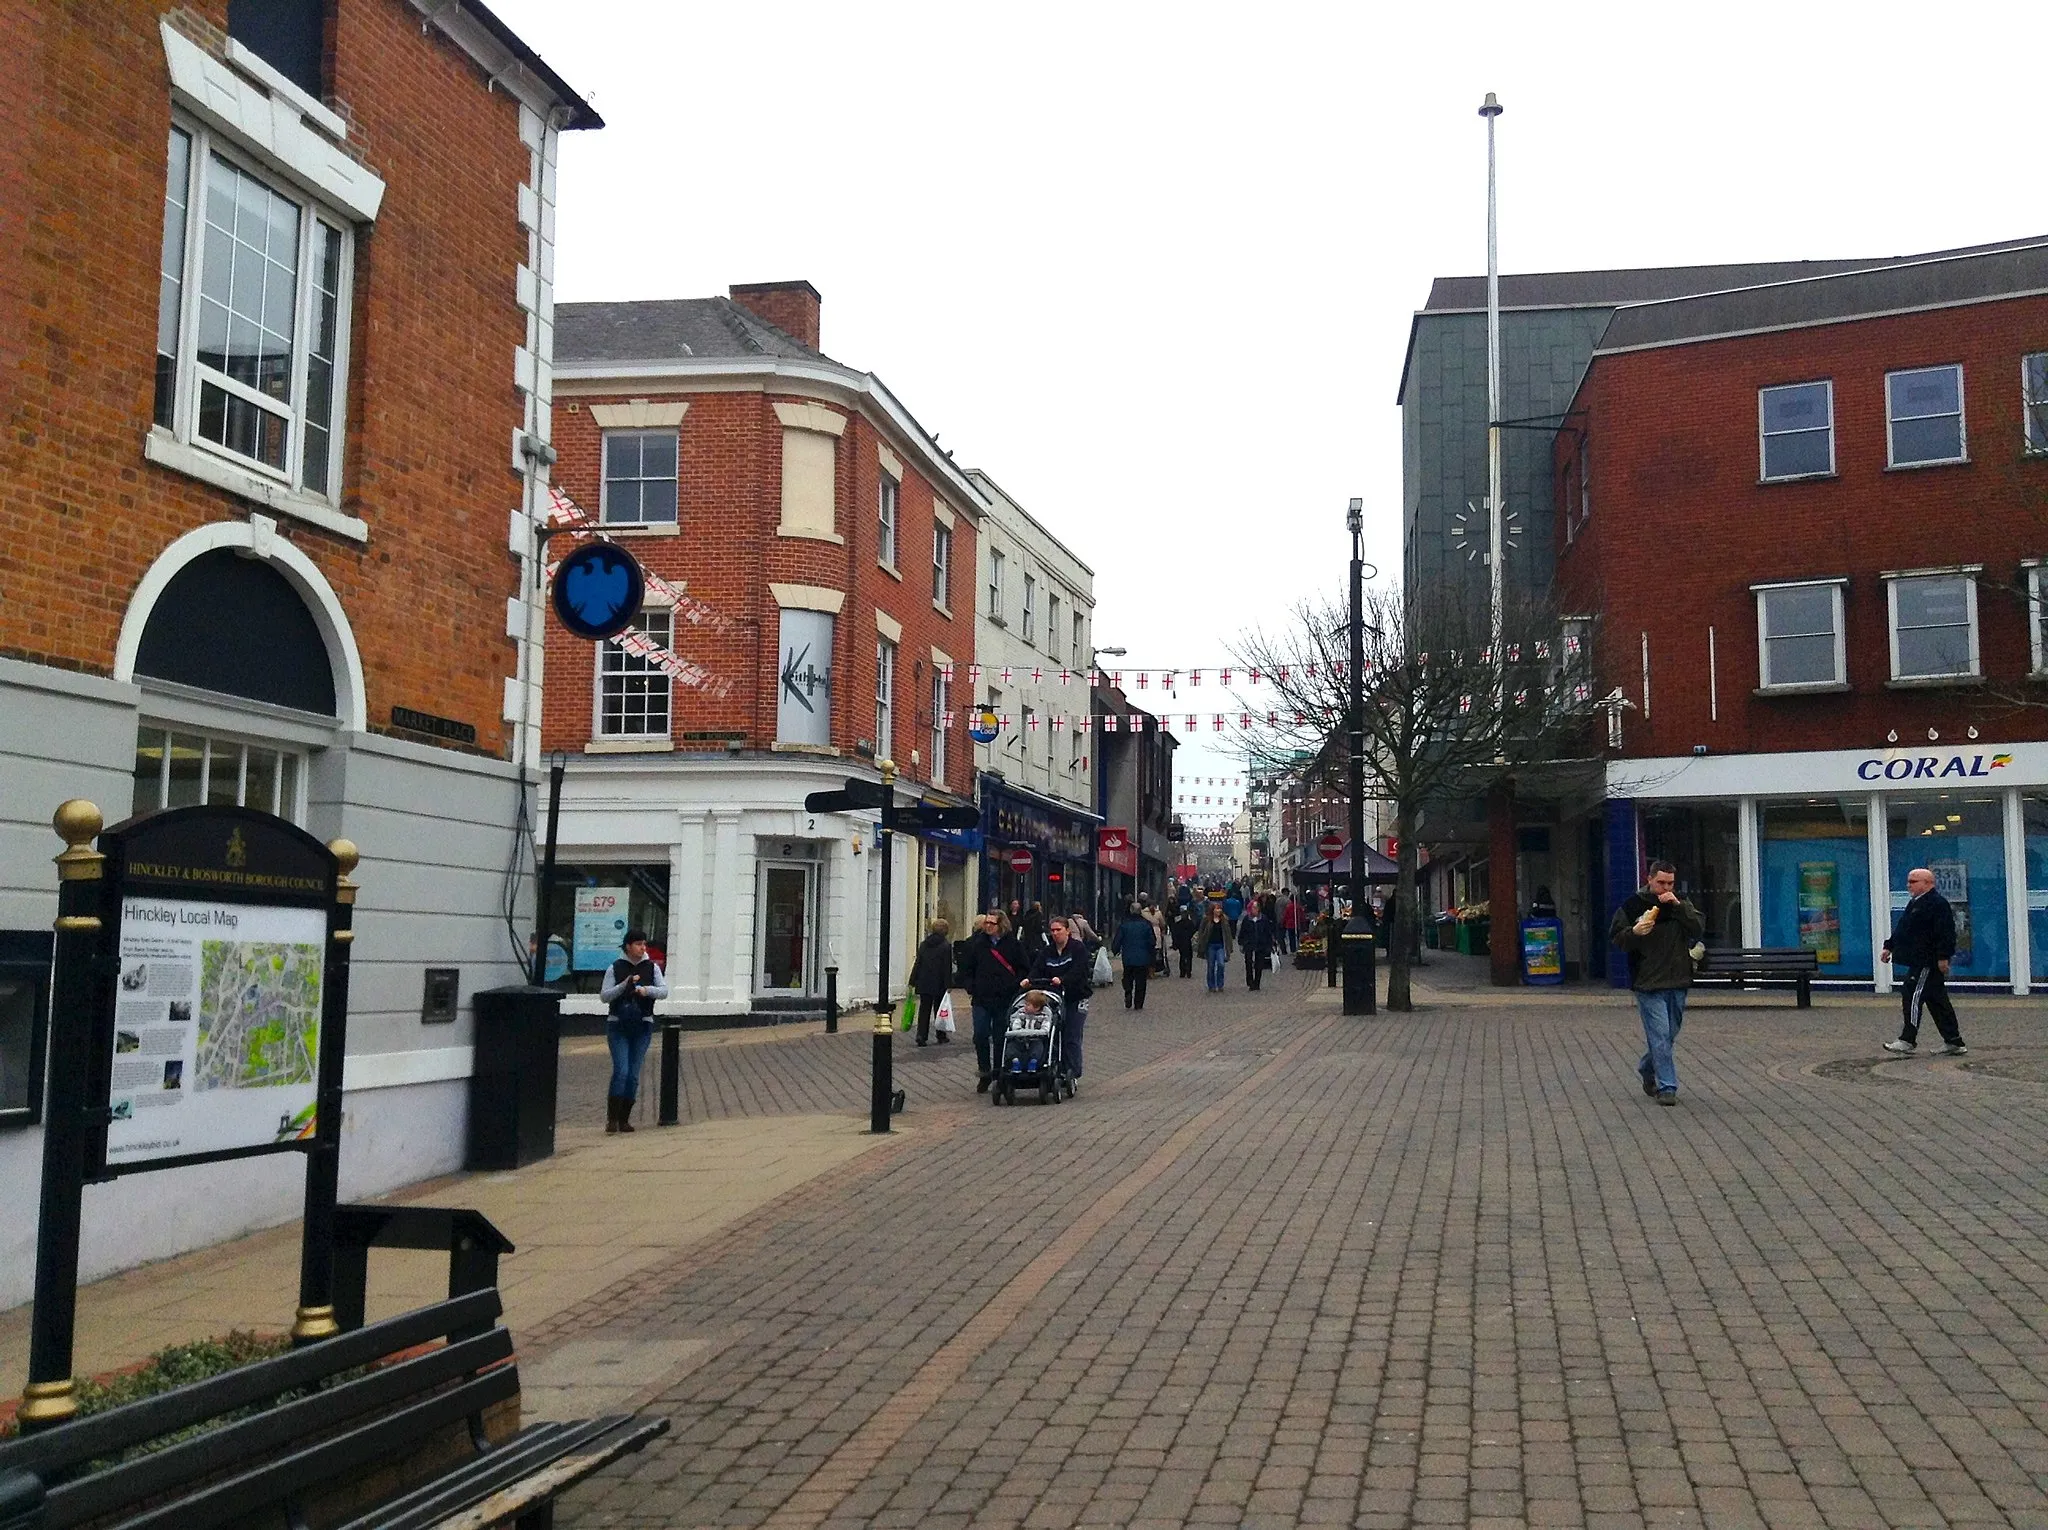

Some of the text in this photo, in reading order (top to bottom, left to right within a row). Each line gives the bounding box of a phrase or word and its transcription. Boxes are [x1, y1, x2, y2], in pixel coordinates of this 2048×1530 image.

[1857, 755, 1989, 780] CORAL
[808, 818, 815, 830] 2
[782, 843, 793, 856] 2
[128, 862, 325, 892] HINCKLEY & BOSWORTH BOROUGH COUNCIL
[592, 895, 616, 908] £79
[125, 904, 238, 930] Hinckley Local Map
